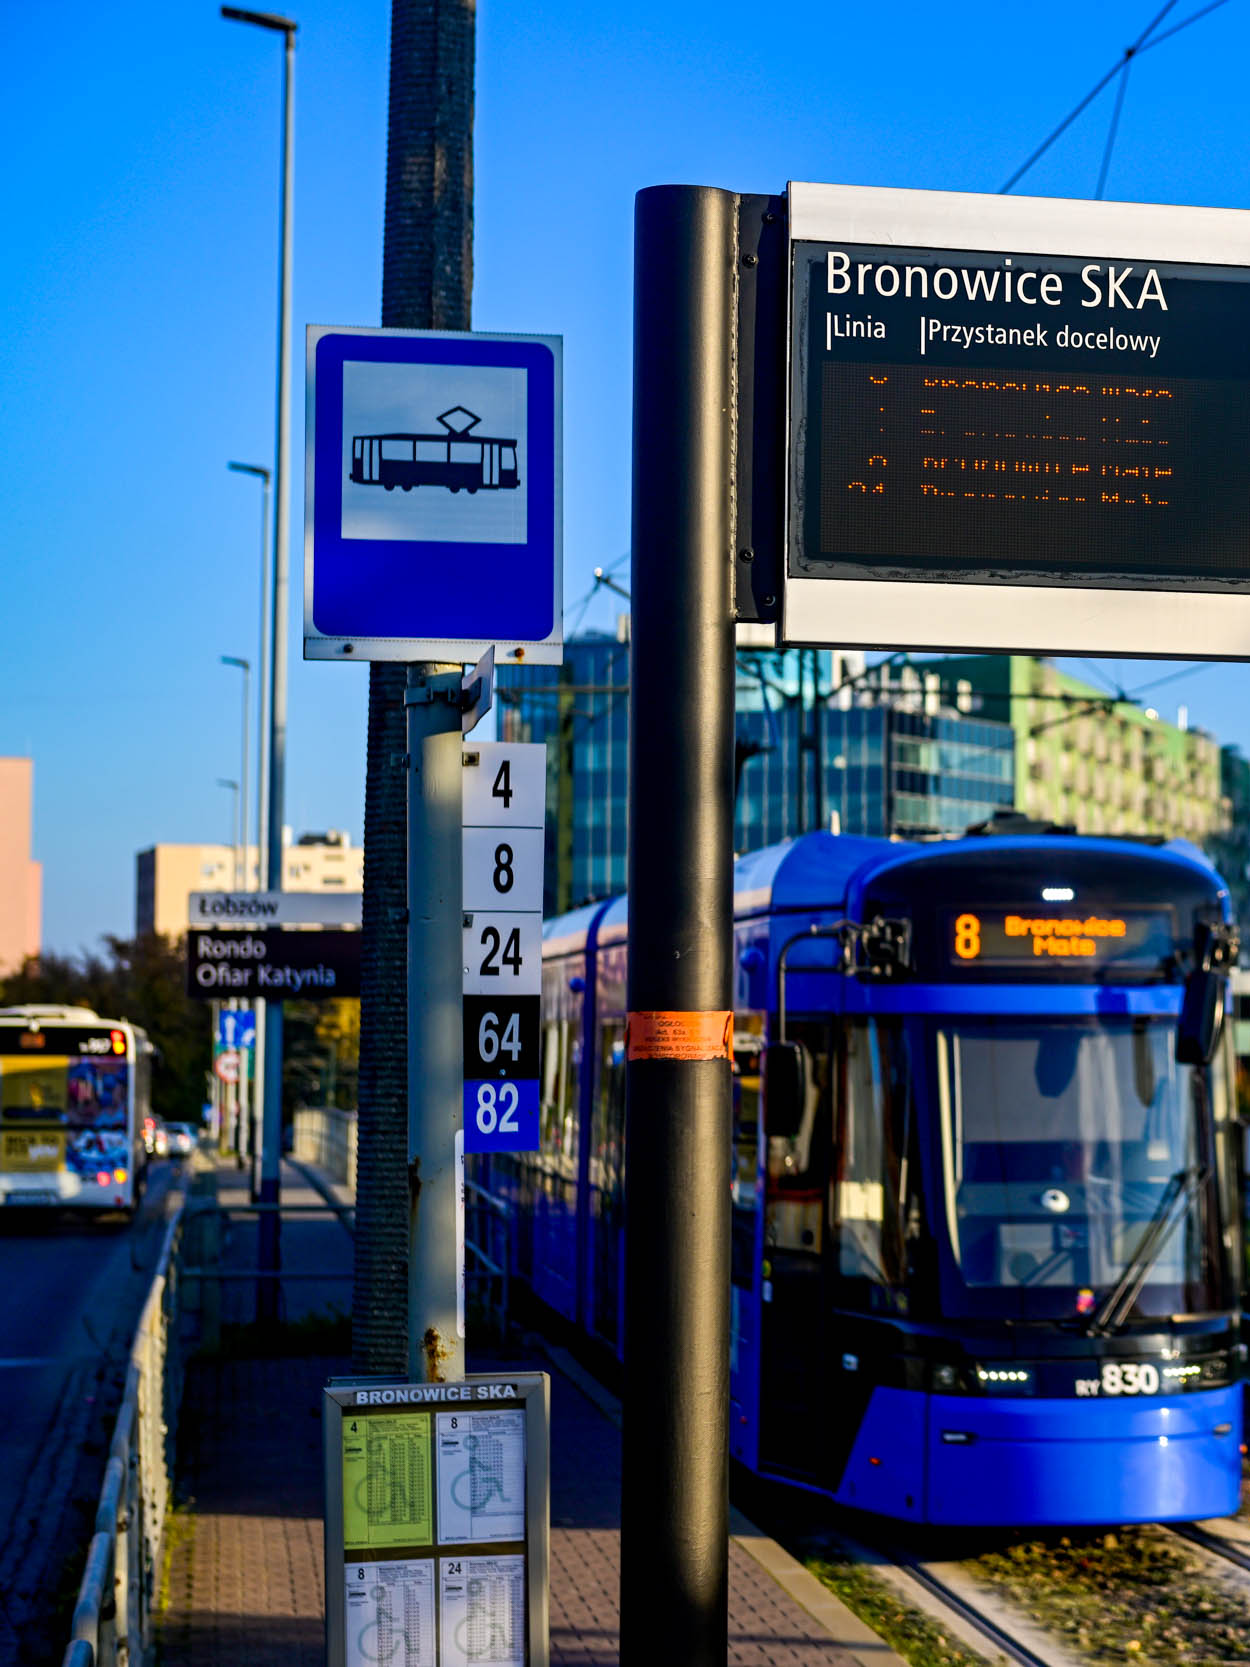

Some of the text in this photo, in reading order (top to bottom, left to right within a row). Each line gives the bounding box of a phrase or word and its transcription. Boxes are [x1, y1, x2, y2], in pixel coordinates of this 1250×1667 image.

[827, 250, 1169, 311] Bronowice SKA
[833, 313, 886, 339] Linia
[928, 318, 1161, 359] Przystanek docelowy
[492, 760, 513, 809] 4
[493, 843, 514, 894] 8
[199, 896, 279, 916] Łobzów
[955, 914, 980, 959] 8
[1005, 915, 1126, 937] Bronowice
[197, 935, 267, 959] Rondo
[479, 926, 522, 976] 24
[196, 962, 337, 992] Ofiar Katynia
[478, 1011, 522, 1063] 64
[476, 1082, 519, 1134] 82
[1101, 1363, 1160, 1395] 830
[356, 1384, 517, 1405] BRONOWICE SKA
[350, 1421, 358, 1433] 4
[450, 1417, 458, 1430] 8
[357, 1567, 366, 1581] 8
[448, 1562, 463, 1575] 24
